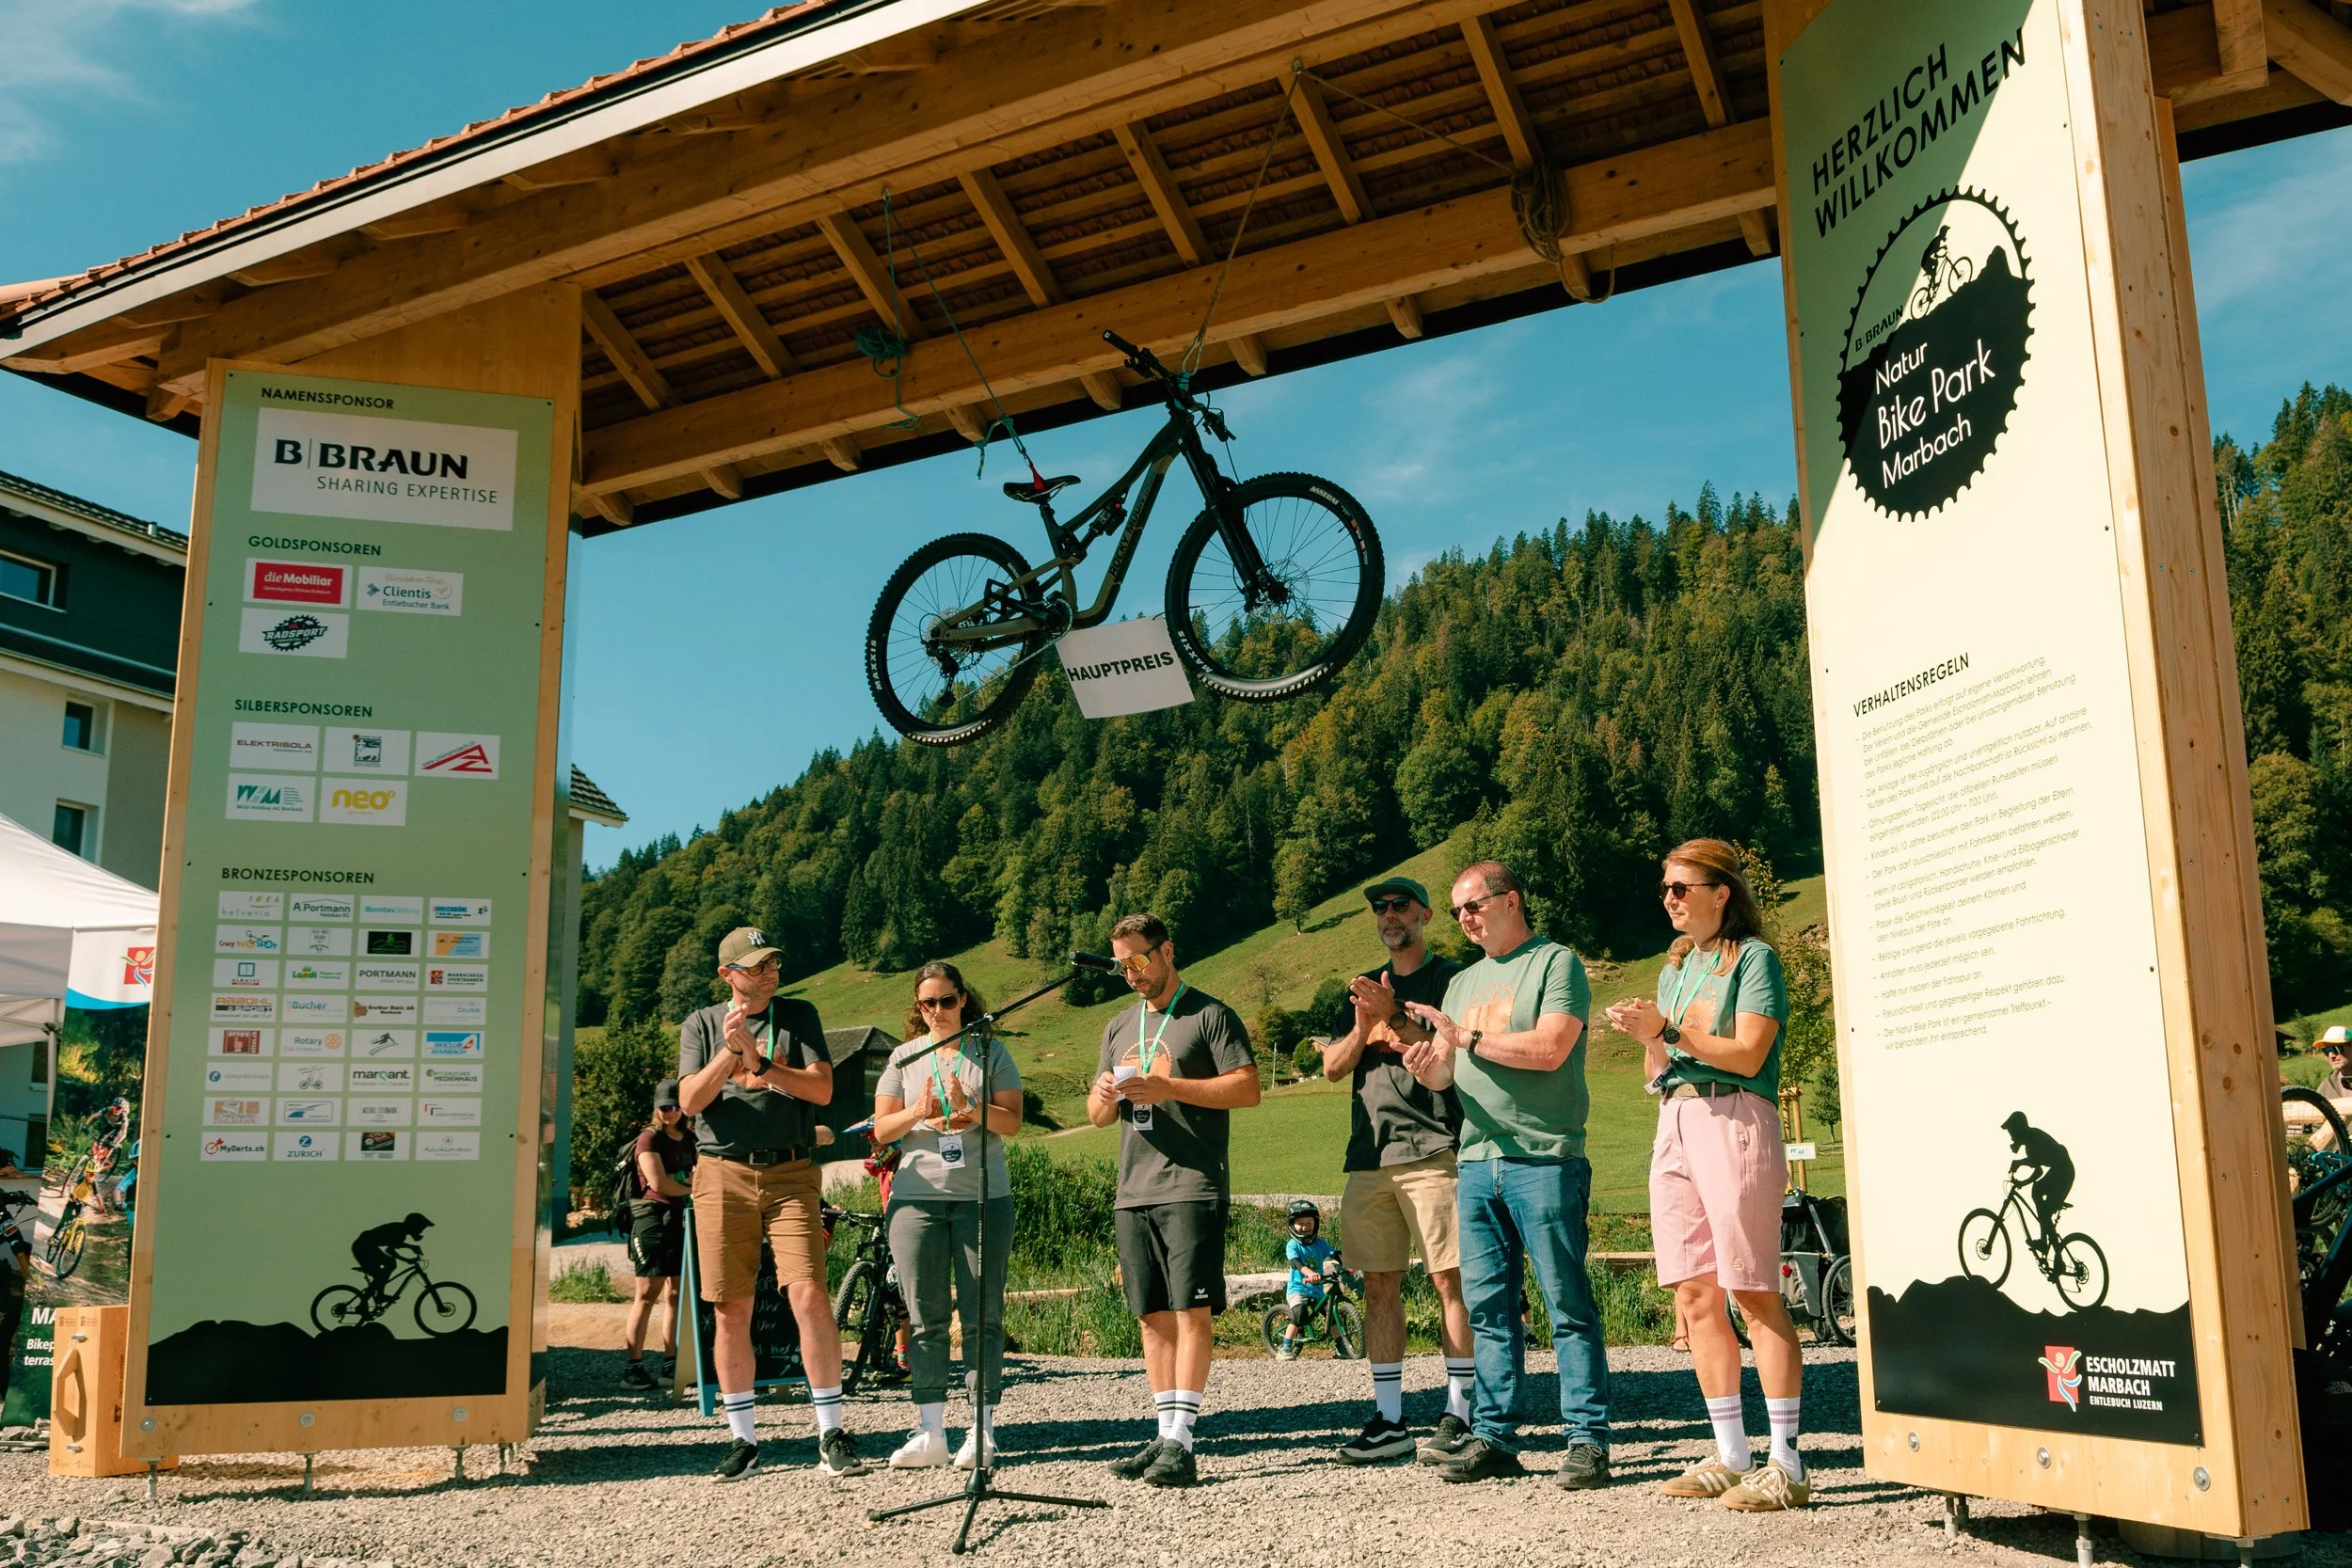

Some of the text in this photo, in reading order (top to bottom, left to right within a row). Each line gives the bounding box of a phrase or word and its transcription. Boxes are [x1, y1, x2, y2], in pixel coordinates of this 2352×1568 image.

[1812, 42, 1948, 196] HERZLICH
[1814, 26, 2026, 238] WILLKOMMEN
[1854, 305, 1903, 352] B BRAUN
[1875, 341, 1928, 395] Natur
[262, 388, 394, 409] NAMENSSPONSOR
[1878, 339, 1995, 450] Bike Park
[274, 438, 468, 479] B BRAUN
[1882, 413, 1972, 489] Marbach
[317, 476, 498, 504] SHARING EXPERTISE
[248, 535, 381, 556] GOLDSPONSOREN
[1110, 533, 1129, 578] ROCKY
[382, 599, 429, 609] Entlebucher
[383, 586, 431, 599] Clientis
[266, 628, 326, 640] RADSPORT
[870, 640, 883, 690] MAXXIS
[1066, 651, 1174, 682] HAUPTPREIS
[1178, 630, 1214, 673] MAXXIS
[1853, 652, 1969, 717] VERHALTENSREGELN
[1861, 657, 2046, 740] Die Benutzung des Parks erfolgt auf eigene Verantwortung.
[234, 699, 373, 718] SILBERSPONSOREN
[1862, 669, 2051, 752] Der Verein und die Gemeinde Escholzmatt-Marbach lehnen
[237, 739, 312, 749] ELEKTRISOLA
[1866, 787, 1876, 797] Die
[1877, 779, 1899, 792] Anlage
[1953, 752, 1967, 764] und
[1968, 736, 2012, 758] unentgeltlich
[2043, 716, 2057, 729] Auf
[2058, 707, 2087, 723] andere
[1885, 793, 1898, 802] des
[1898, 786, 1915, 798] Parks
[1915, 782, 1929, 792] und
[1929, 774, 1940, 787] auf
[1941, 772, 1952, 783] die
[1953, 752, 2003, 778] Nachbarschaft
[2012, 736, 2046, 755] Rücksicht
[2047, 734, 2057, 743] zu
[2058, 721, 2092, 739] nehmen.
[331, 789, 389, 811] neo
[1870, 847, 1889, 859] Kinder
[1890, 845, 1899, 853] bis
[1908, 836, 1926, 847] Jahre
[1927, 825, 1959, 842] besuchen
[1959, 820, 1973, 831] den
[1974, 813, 1990, 825] Park
[1990, 812, 1997, 820] in
[1998, 800, 2036, 817] Begleitung
[2037, 794, 2050, 805] der
[1871, 868, 1883, 879] Der
[1883, 864, 1897, 874] Park
[1912, 846, 1956, 865] ausschliesslich
[1957, 840, 1968, 850] mit
[1969, 830, 2007, 847] Fahrrädern
[2008, 819, 2041, 835] befahren
[2042, 810, 2073, 824] werden.
[222, 867, 374, 883] BRONZESPONSOREN
[303, 903, 351, 912] Portmann
[1875, 879, 2026, 928] Passe die Geschwindigkeit deinem Können und
[1901, 942, 1931, 956] zwingend
[1932, 938, 1944, 947] die
[1967, 921, 2013, 939] vorgegebene
[2015, 909, 2066, 927] Fahrtrichtung.
[293, 970, 318, 979] Landi
[359, 970, 416, 978] PORTMANN
[293, 1001, 327, 1010] Bucher
[1924, 998, 1937, 1009] und
[1938, 990, 1982, 1008] gegenseitiger
[1984, 983, 2011, 997] Respekt
[2012, 978, 2043, 993] gehören
[2045, 974, 2066, 985] dazu.
[294, 1037, 322, 1046] Rotary
[220, 1145, 265, 1153] MyDarts.ch
[2086, 1356, 2176, 1378] ESCHOLZMATT
[2088, 1376, 2151, 1396] MARBACH
[2090, 1396, 2163, 1411] ENTLEBUCH LUZERN
